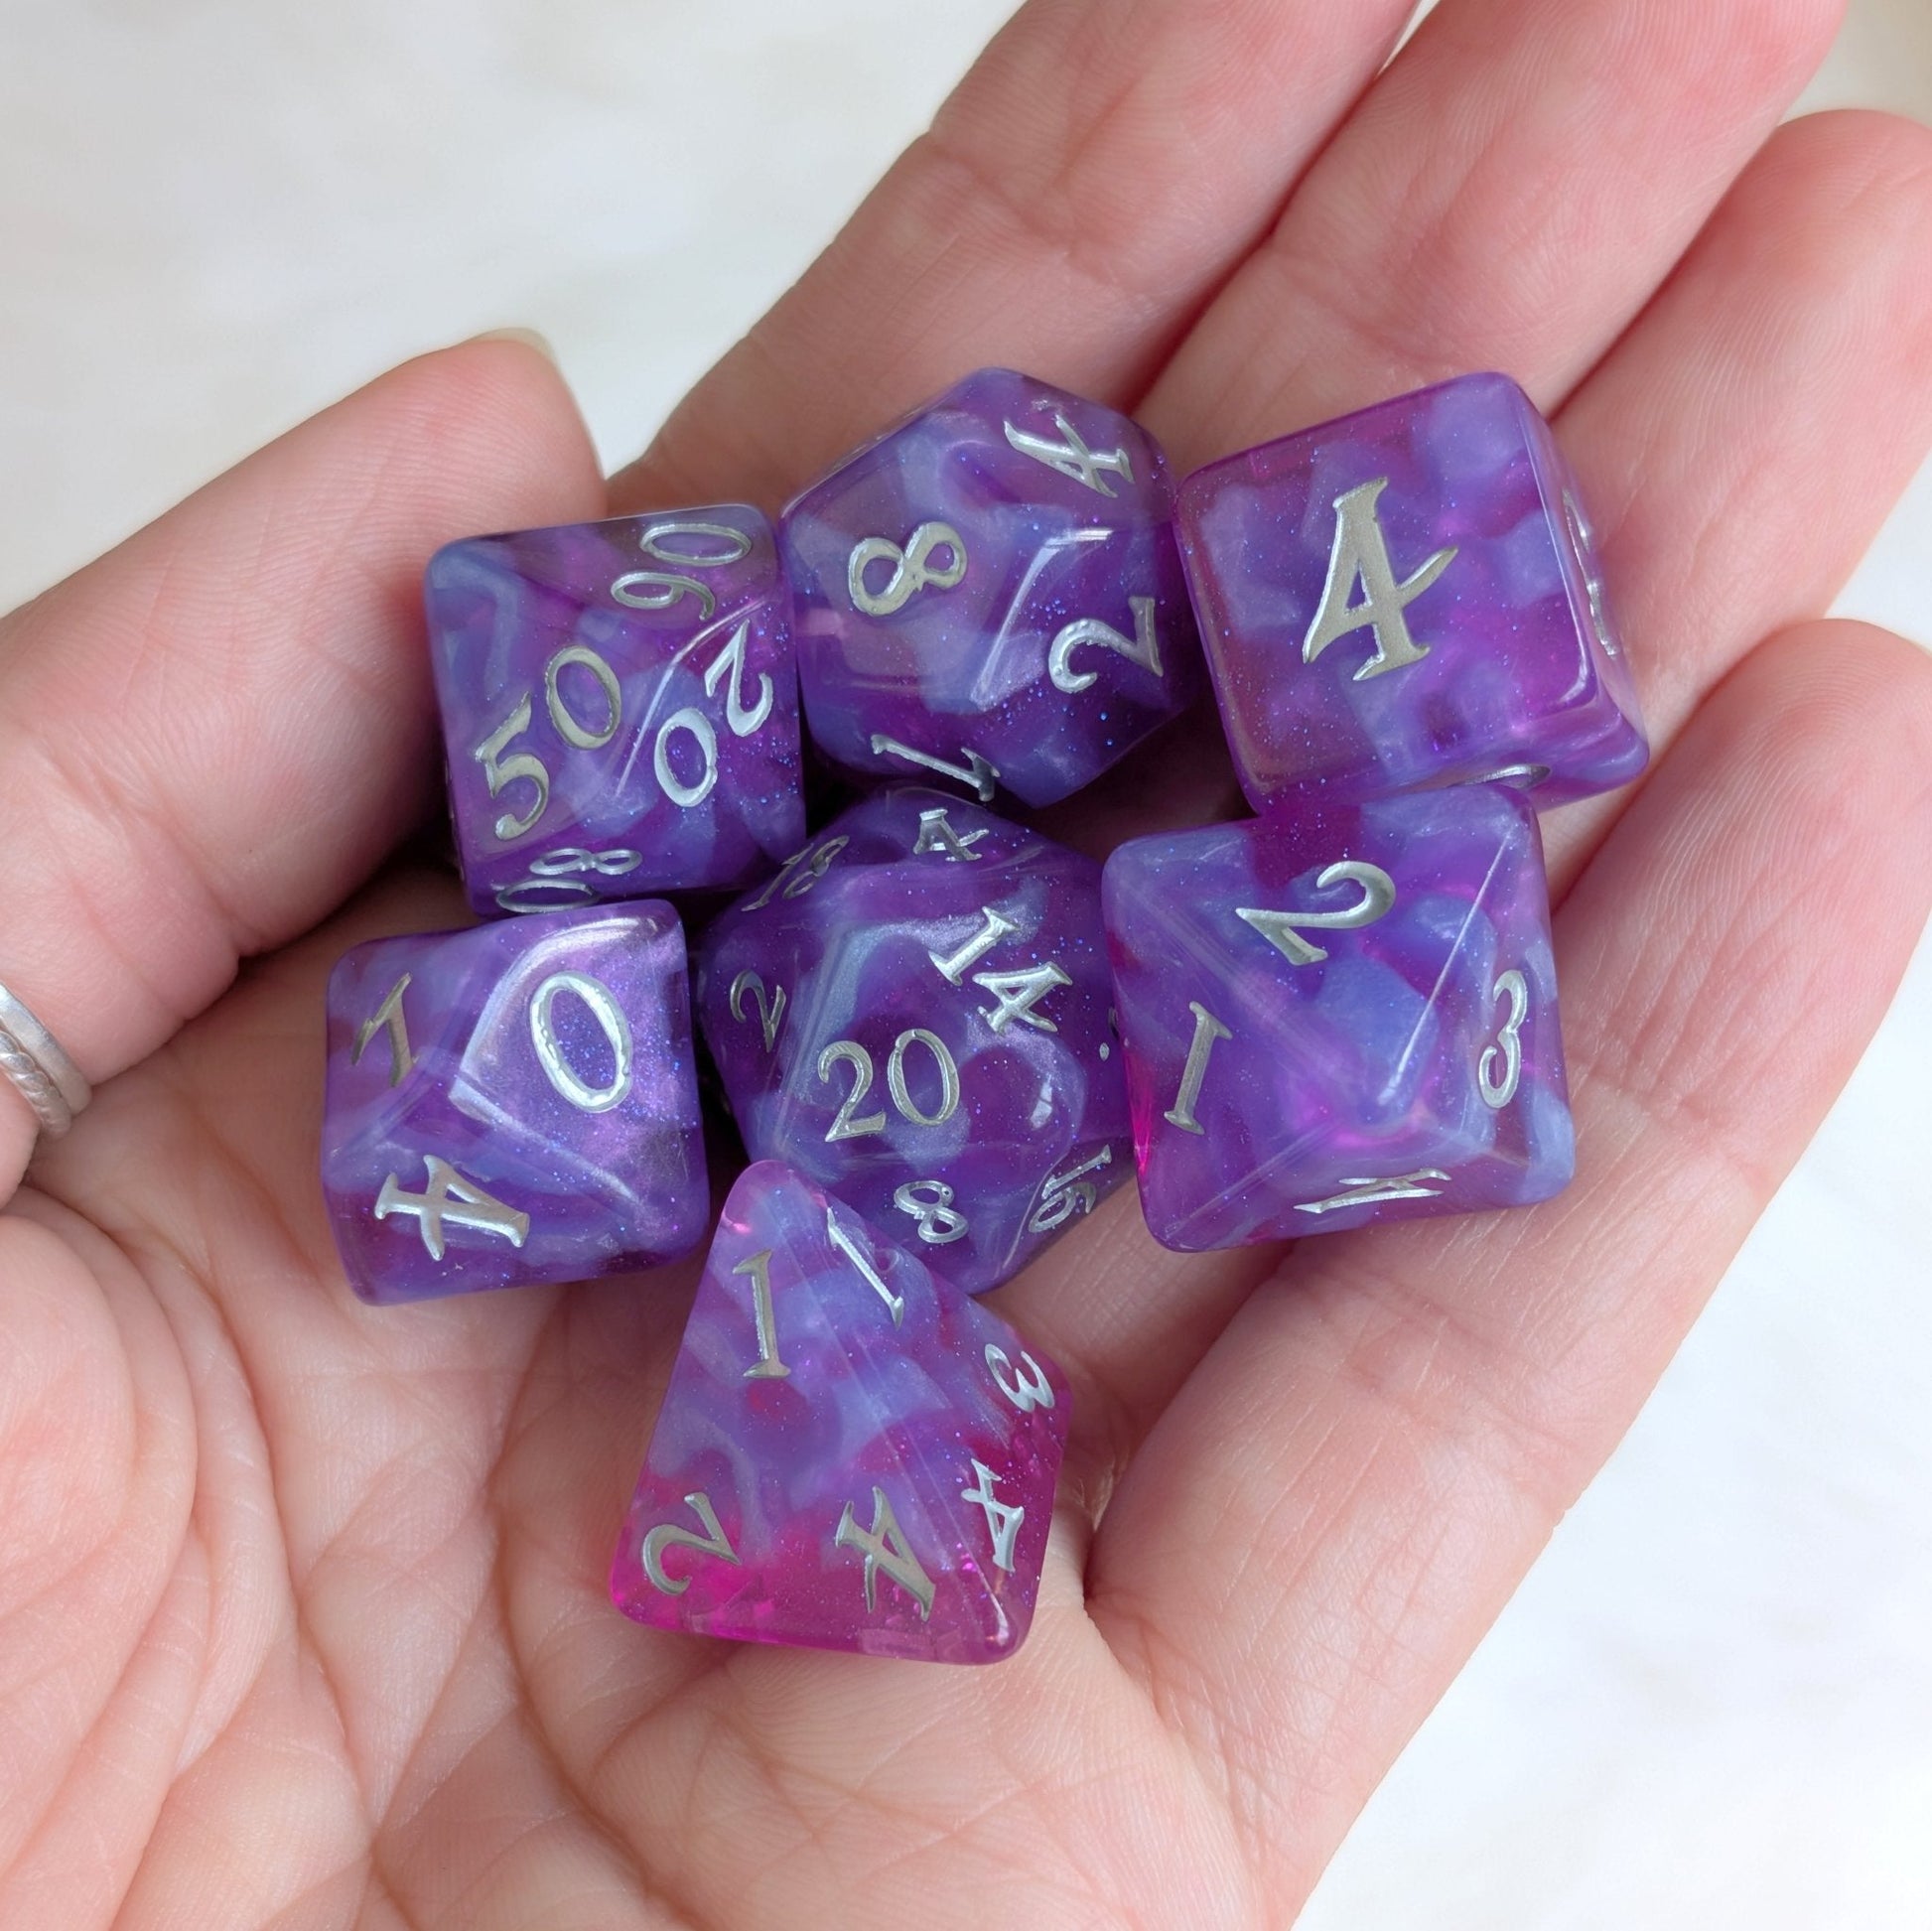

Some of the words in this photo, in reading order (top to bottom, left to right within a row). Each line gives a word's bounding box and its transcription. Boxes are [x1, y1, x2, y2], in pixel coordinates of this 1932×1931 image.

[1004, 415, 1135, 497] 4
[611, 522, 752, 621] 90
[849, 521, 967, 617] 8
[1303, 477, 1458, 681] 4
[1048, 596, 1165, 693] 2
[475, 645, 621, 841] 50
[654, 619, 773, 807] 20
[913, 808, 989, 861] 4
[1235, 862, 1396, 965] 2
[730, 970, 786, 1052] 2
[928, 906, 1072, 1035] 14
[530, 971, 632, 1113] 0
[817, 1029, 960, 1142] 20
[1164, 1001, 1233, 1135] 1
[1478, 970, 1527, 1108] 3
[375, 1155, 529, 1261] 4
[894, 1180, 969, 1243] 8
[733, 1249, 791, 1379] 1
[984, 1343, 1054, 1413] 3
[641, 1491, 741, 1596] 2
[835, 1486, 936, 1622] 4
[961, 1458, 1024, 1573] 4
